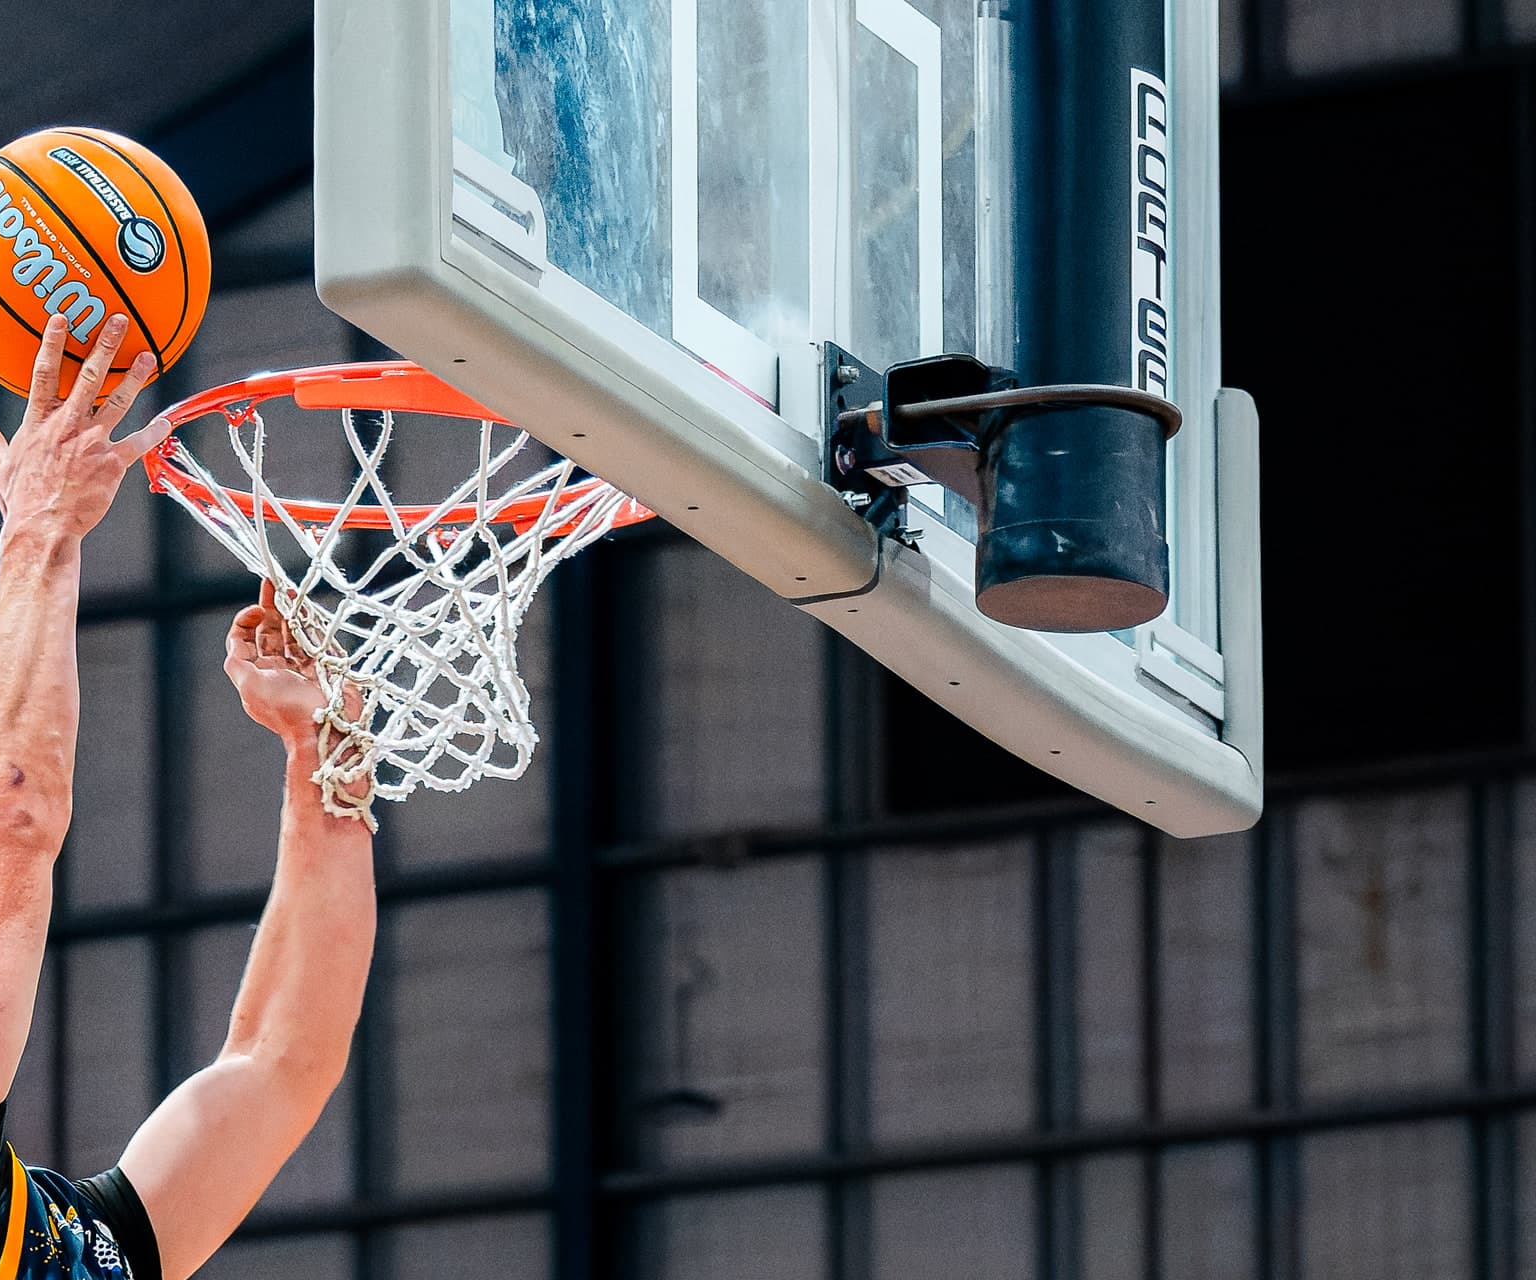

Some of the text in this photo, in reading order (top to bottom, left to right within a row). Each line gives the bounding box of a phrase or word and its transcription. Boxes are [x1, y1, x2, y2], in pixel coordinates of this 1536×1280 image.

[78, 163, 132, 221] BASKETBALL
[20, 196, 92, 280] OFFICIAL GAME BALL
